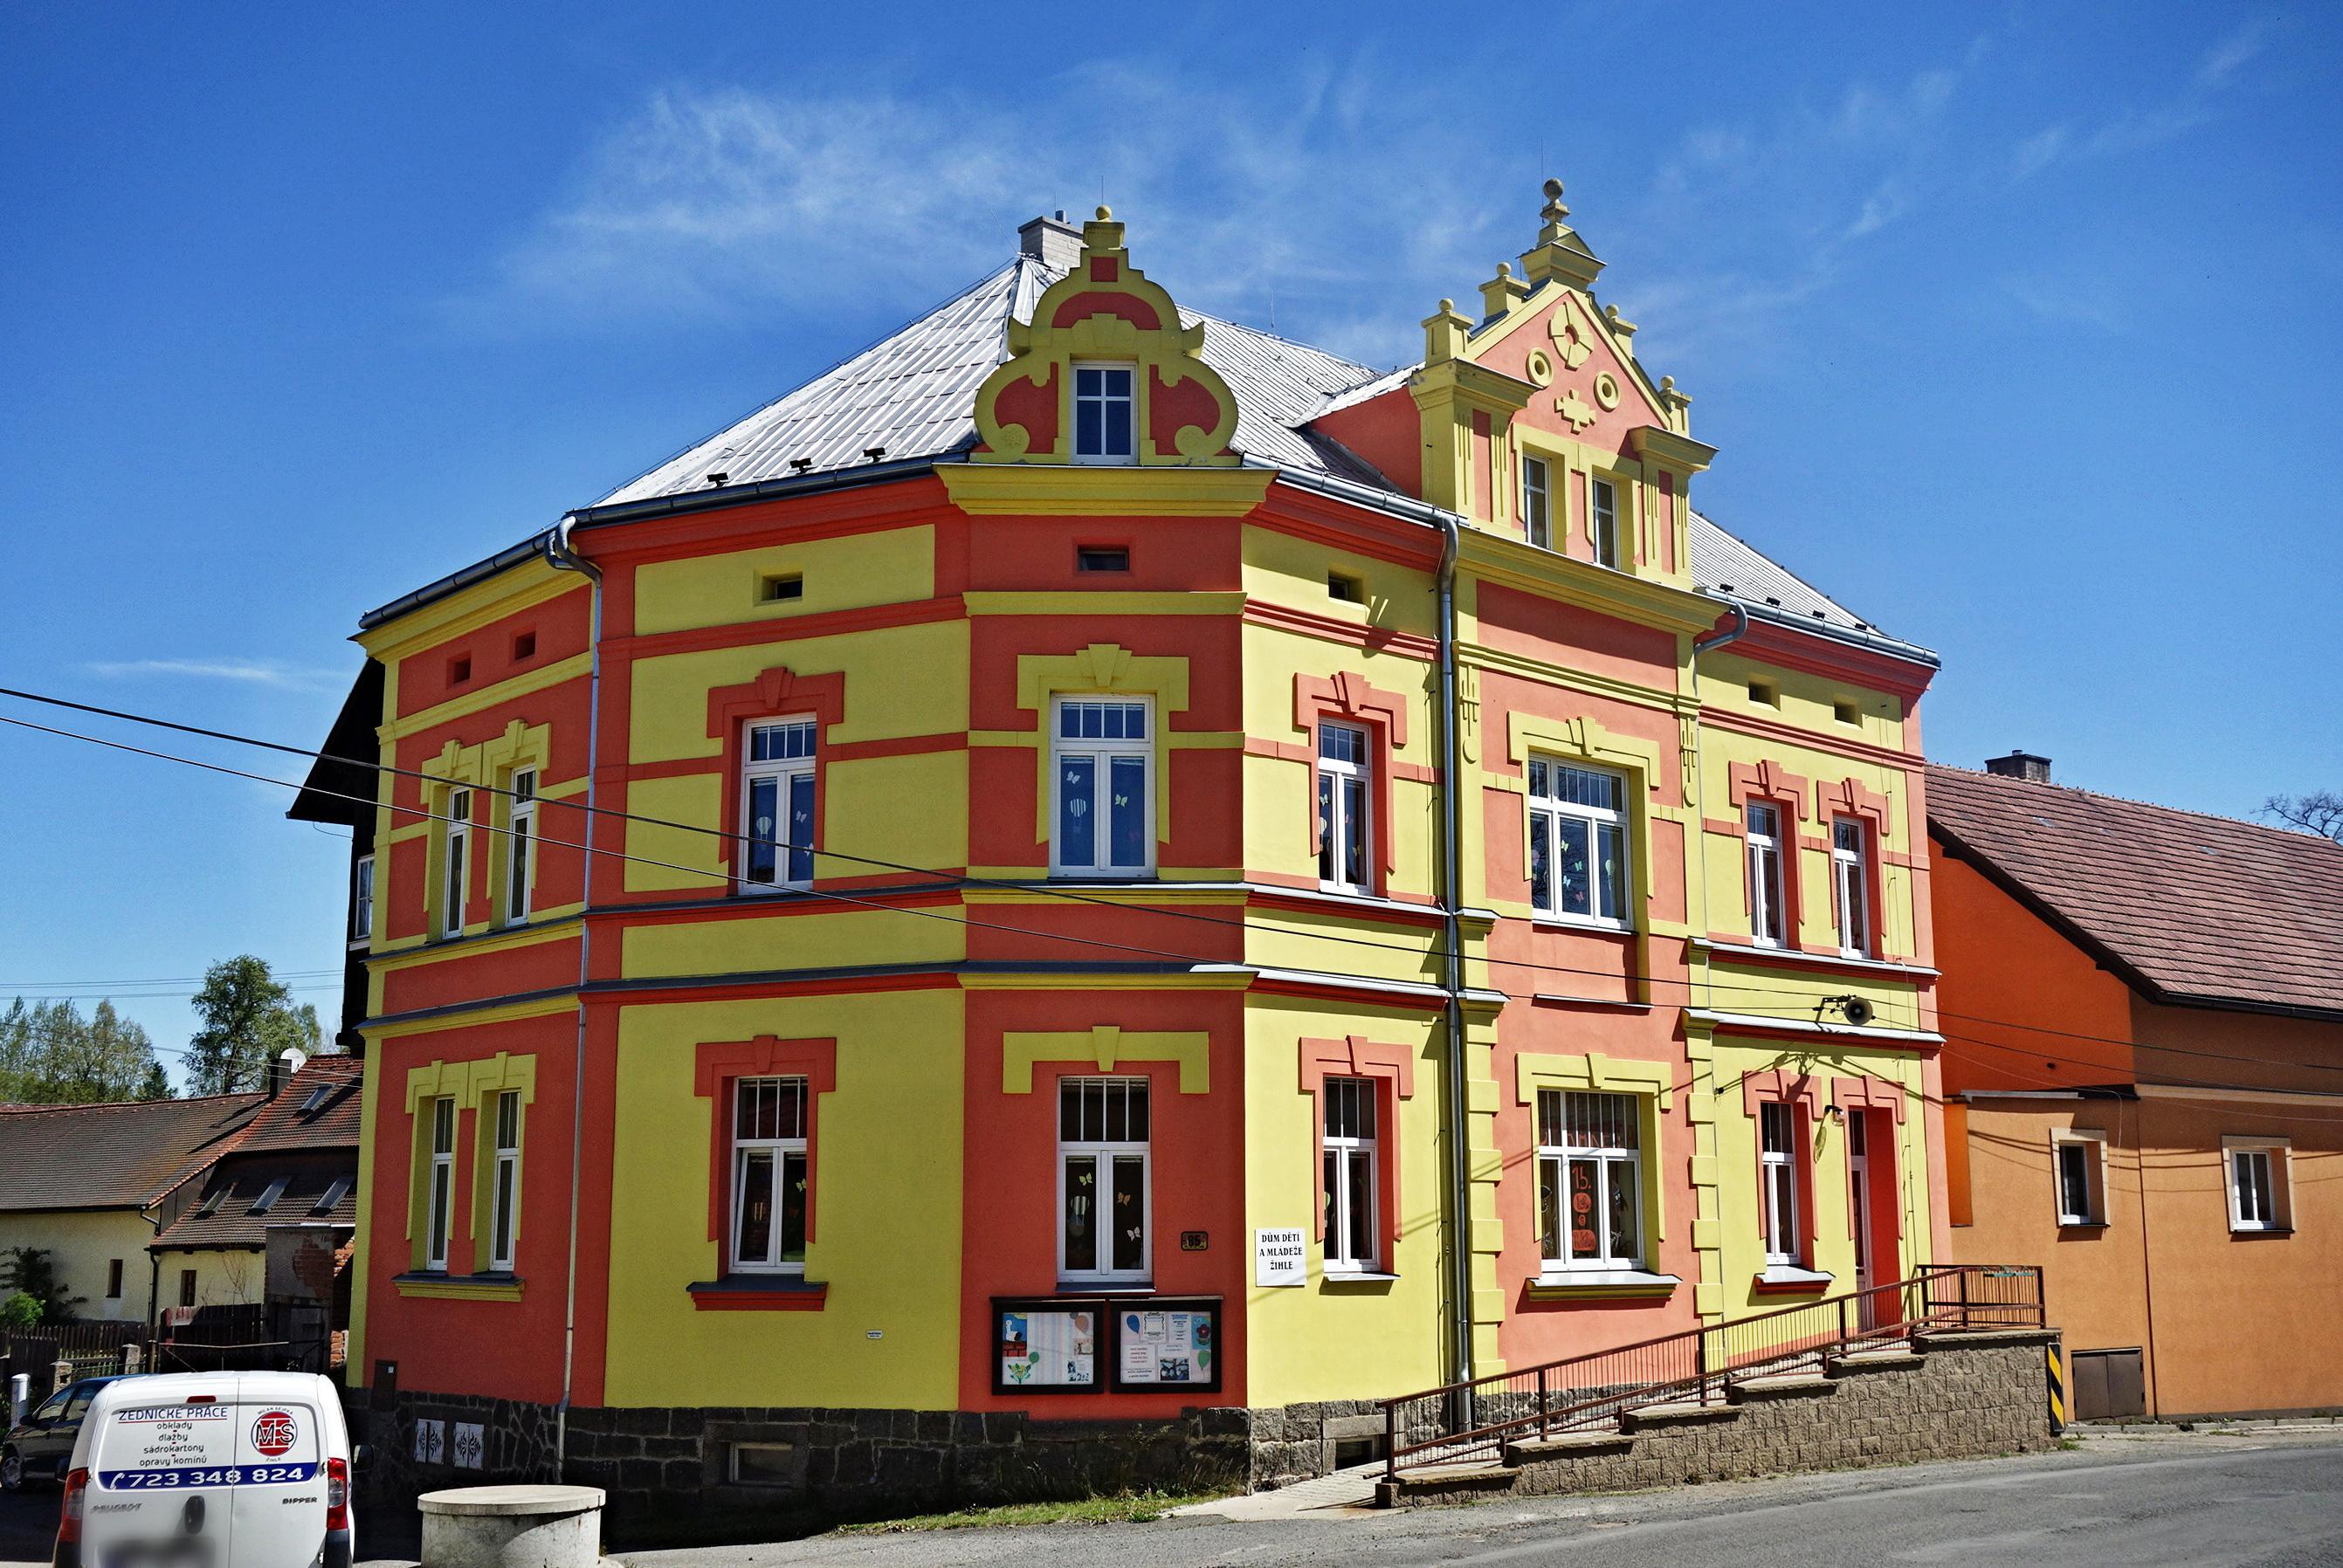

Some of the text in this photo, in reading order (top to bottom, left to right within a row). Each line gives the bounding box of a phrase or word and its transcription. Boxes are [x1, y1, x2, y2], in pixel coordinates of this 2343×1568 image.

[1262, 1232, 1300, 1242] DŮM DĚTÍ
[1267, 1246, 1303, 1256] MLÁDEŽE
[1270, 1260, 1293, 1270] ŽIHLE
[118, 1405, 228, 1420] ZEDNICKÉ PRÁCE
[156, 1421, 193, 1430] obklady
[158, 1434, 188, 1442] dlažby
[143, 1444, 204, 1454] sádrokartony
[140, 1455, 207, 1468] opravy komínů
[128, 1467, 304, 1488] 723 348 824
